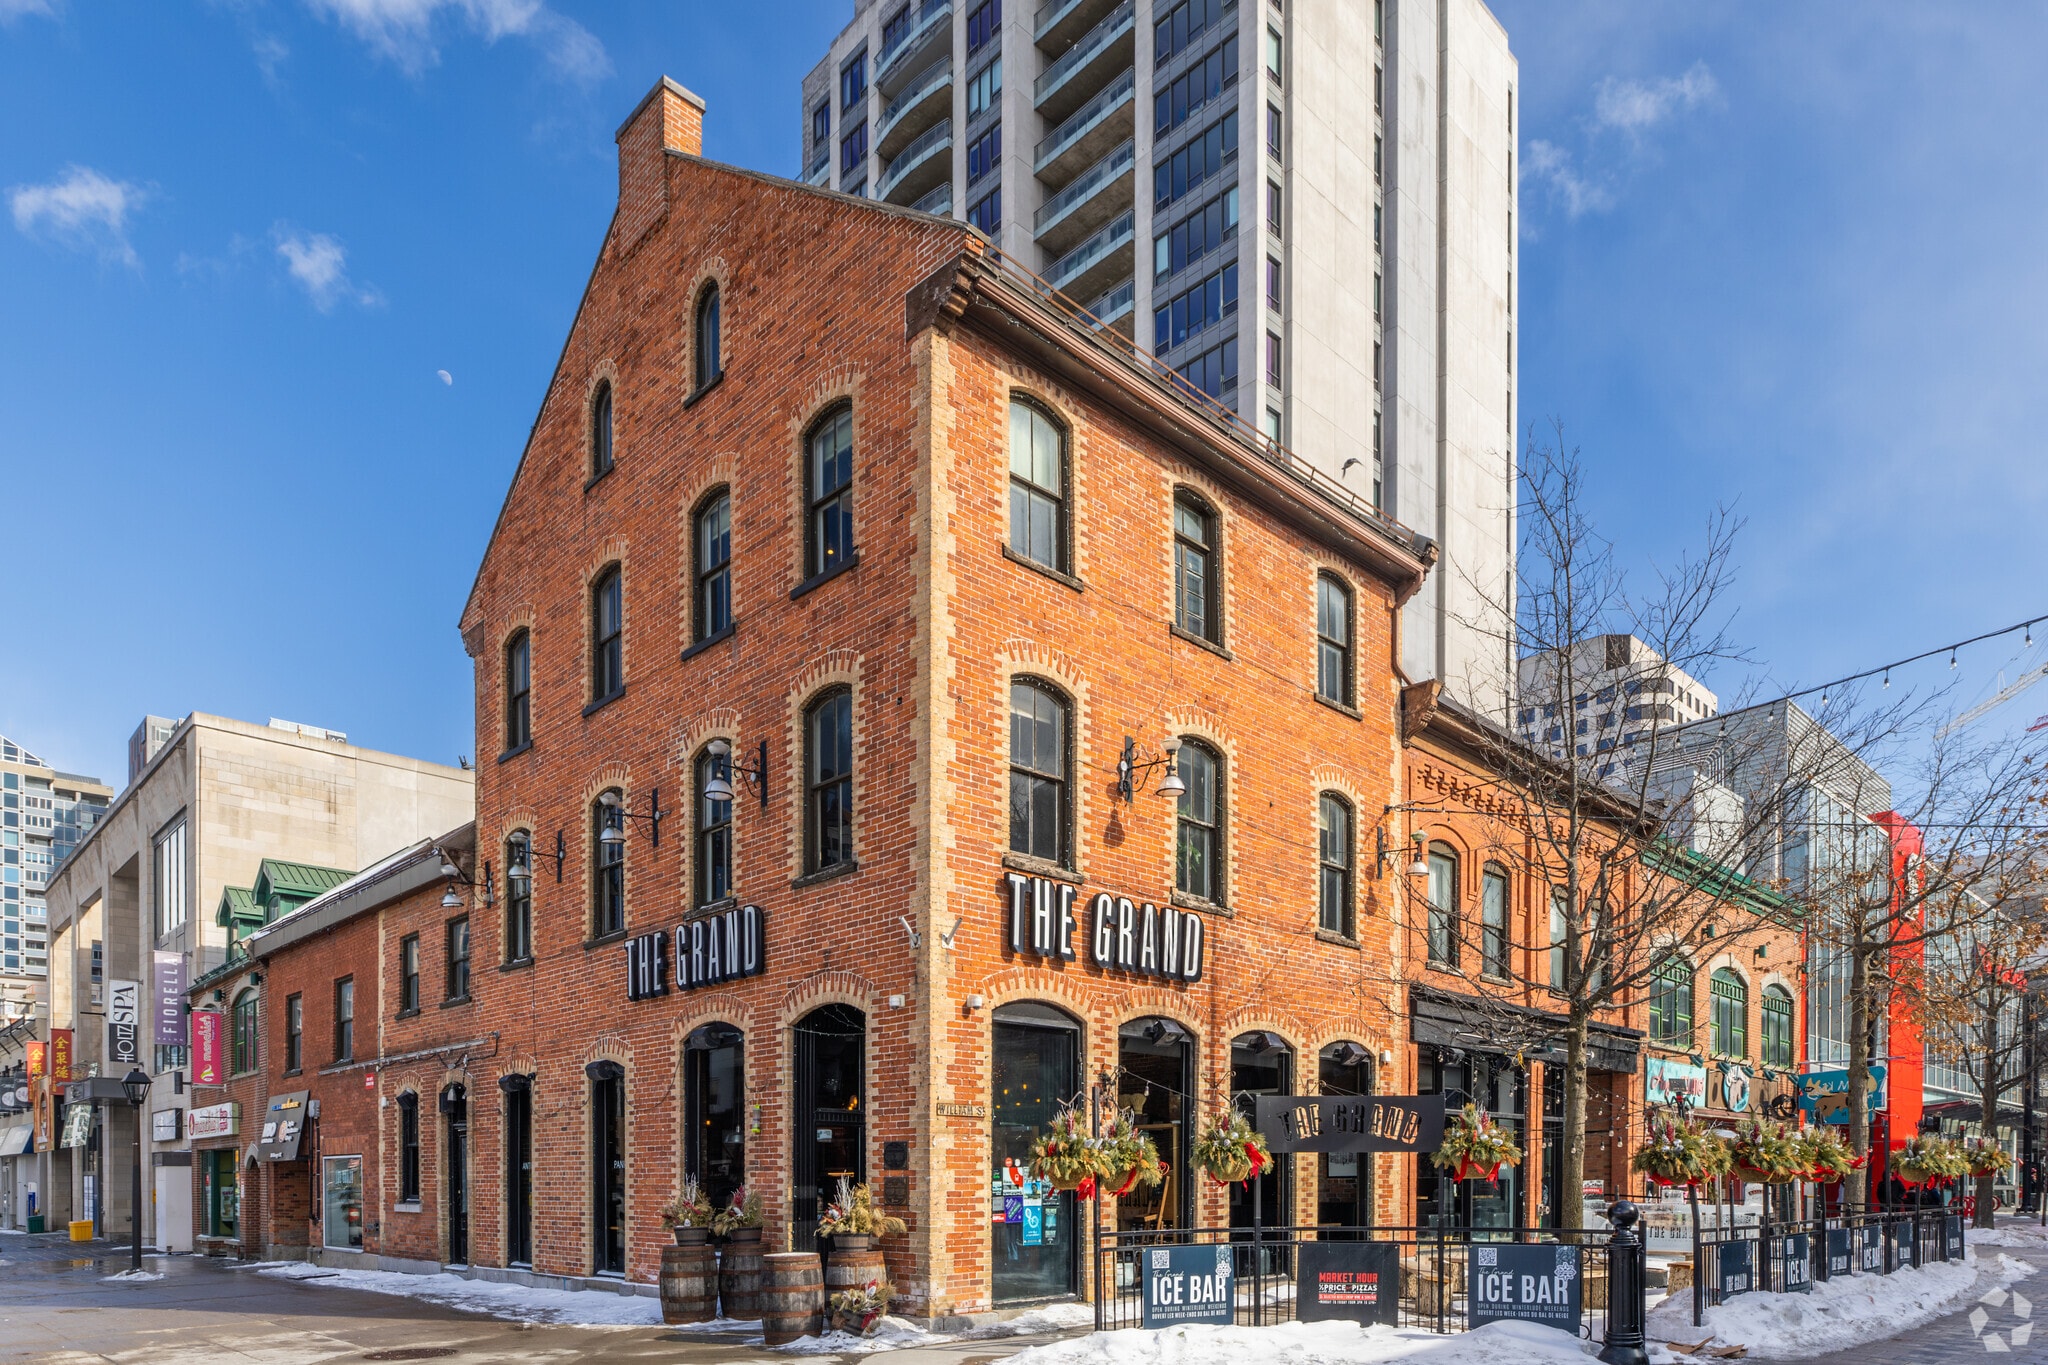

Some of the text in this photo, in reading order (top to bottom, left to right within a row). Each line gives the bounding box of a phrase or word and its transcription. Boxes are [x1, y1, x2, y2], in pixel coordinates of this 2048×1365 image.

[1005, 873, 1203, 980] THE GRAND
[624, 905, 761, 1000] THE GRAND
[162, 958, 178, 1034] FIORELLA
[938, 1104, 974, 1116] WILLIAM
[1277, 1103, 1422, 1145] THE GRAND
[1319, 1272, 1378, 1283] MARKET HOUR
[1787, 1260, 1800, 1285] ICE
[1152, 1275, 1227, 1305] ICE BAR
[1478, 1274, 1569, 1304] ICE BAR
